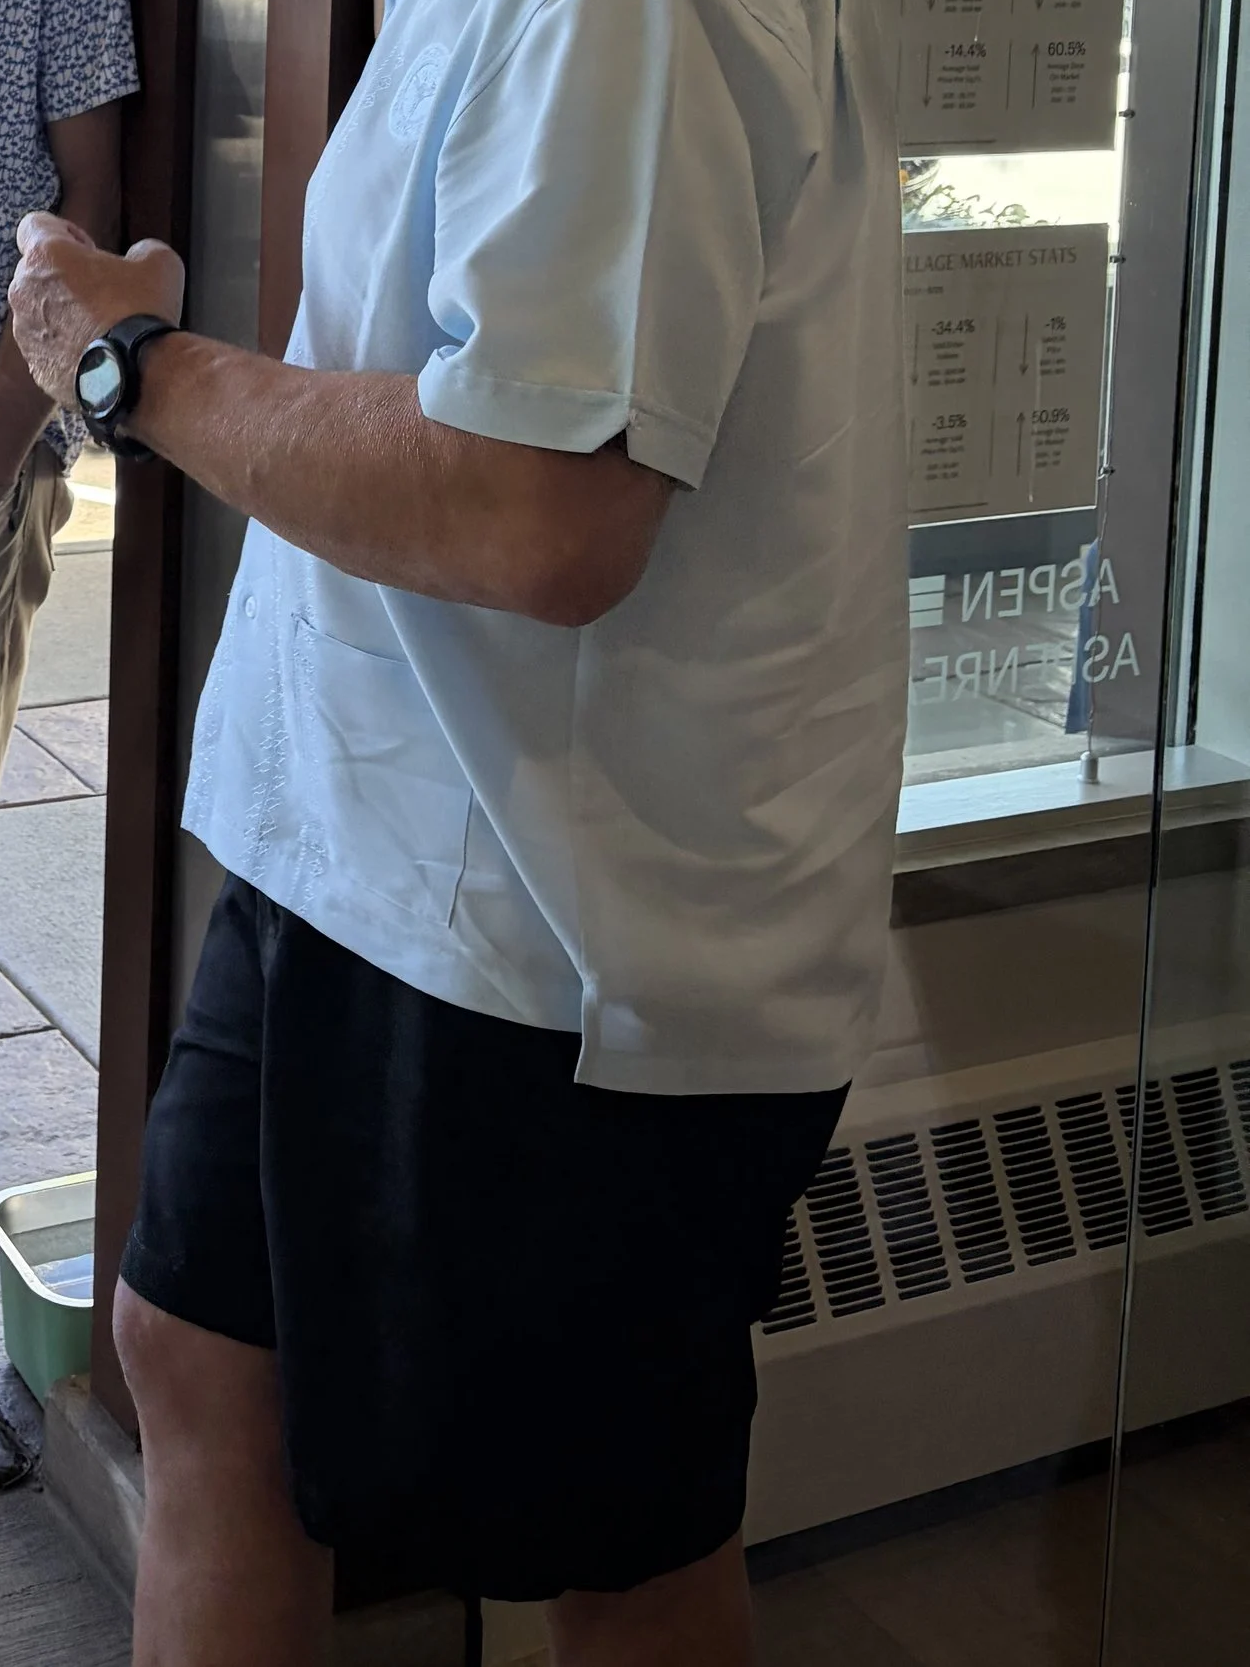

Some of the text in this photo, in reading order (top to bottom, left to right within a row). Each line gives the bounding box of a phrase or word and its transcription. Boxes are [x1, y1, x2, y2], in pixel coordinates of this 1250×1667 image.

[945, 43, 986, 58] -14.4%
[1047, 41, 1086, 56] 60.5%
[906, 246, 1077, 273] LLAGE MARKET STATS
[931, 318, 976, 335] -34.4%
[1045, 316, 1066, 332] -1%
[932, 414, 967, 430] -3.5%
